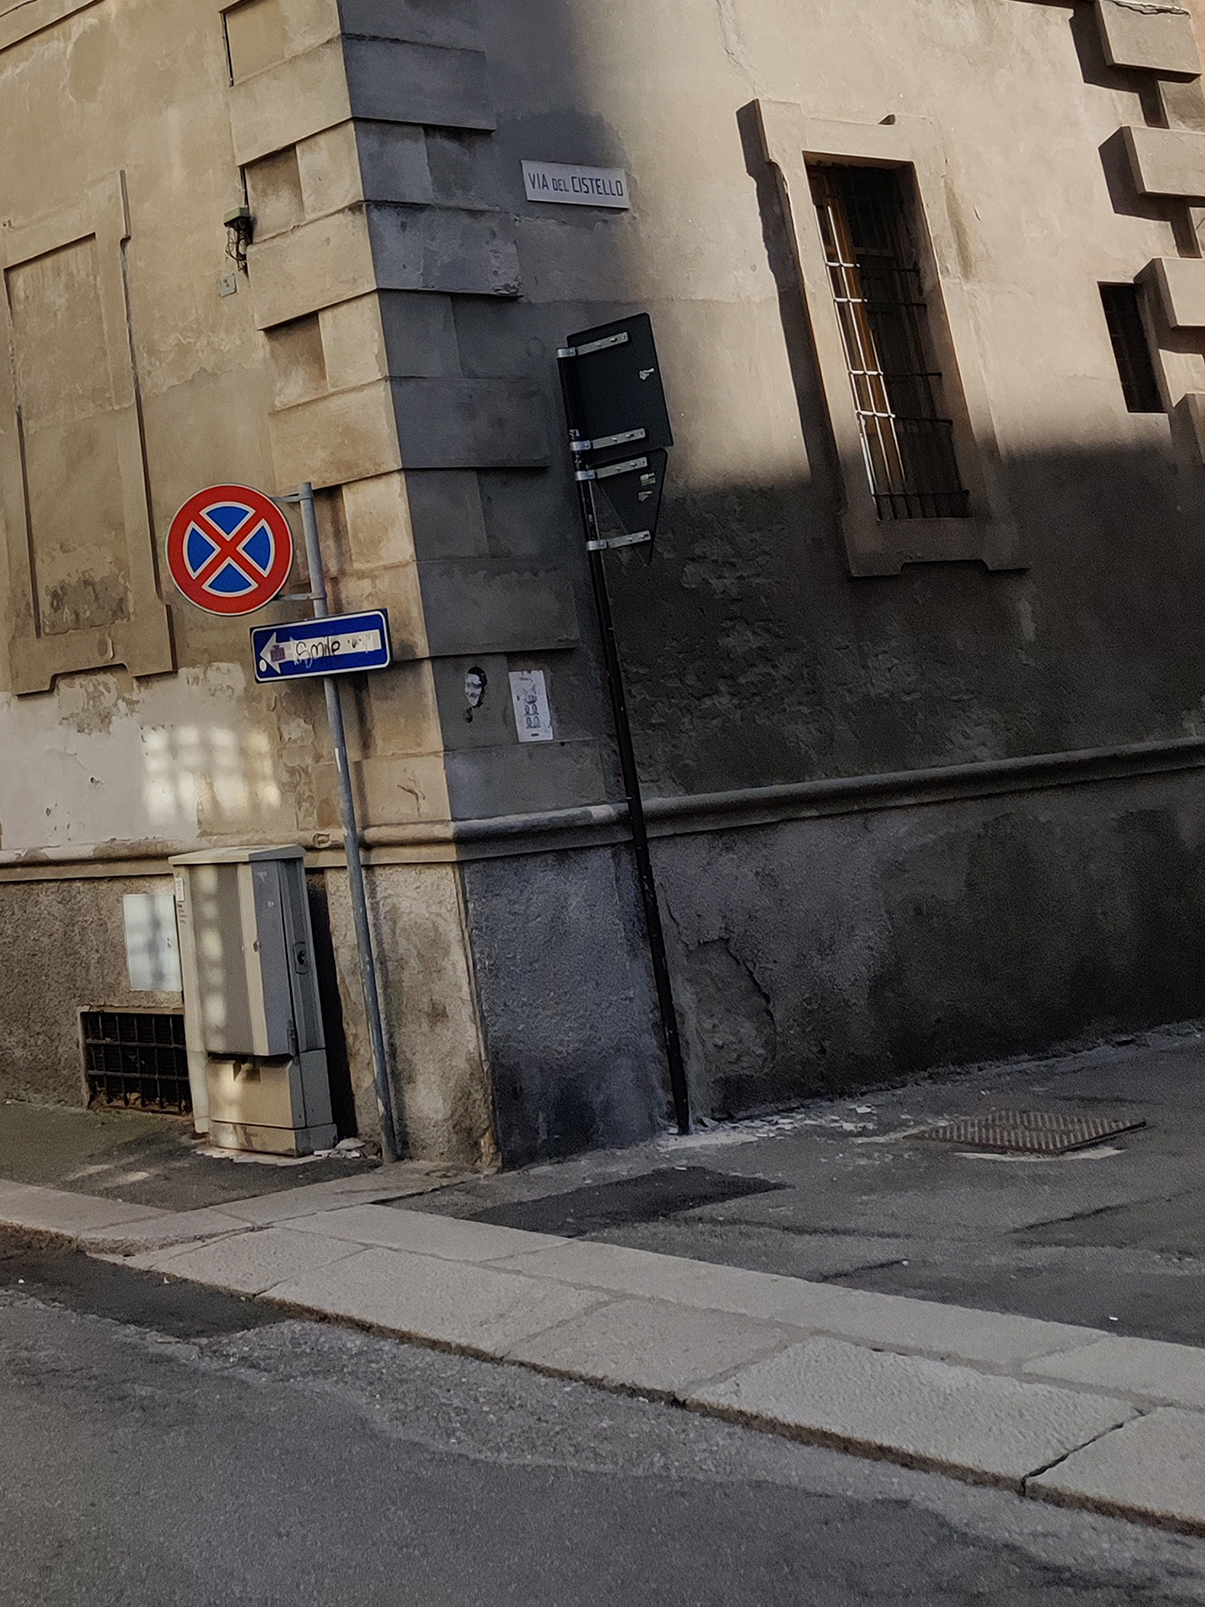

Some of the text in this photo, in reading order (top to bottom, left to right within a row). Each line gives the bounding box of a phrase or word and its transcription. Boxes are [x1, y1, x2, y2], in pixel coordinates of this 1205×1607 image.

[528, 172, 624, 196] VIA DEL CISTELLO
